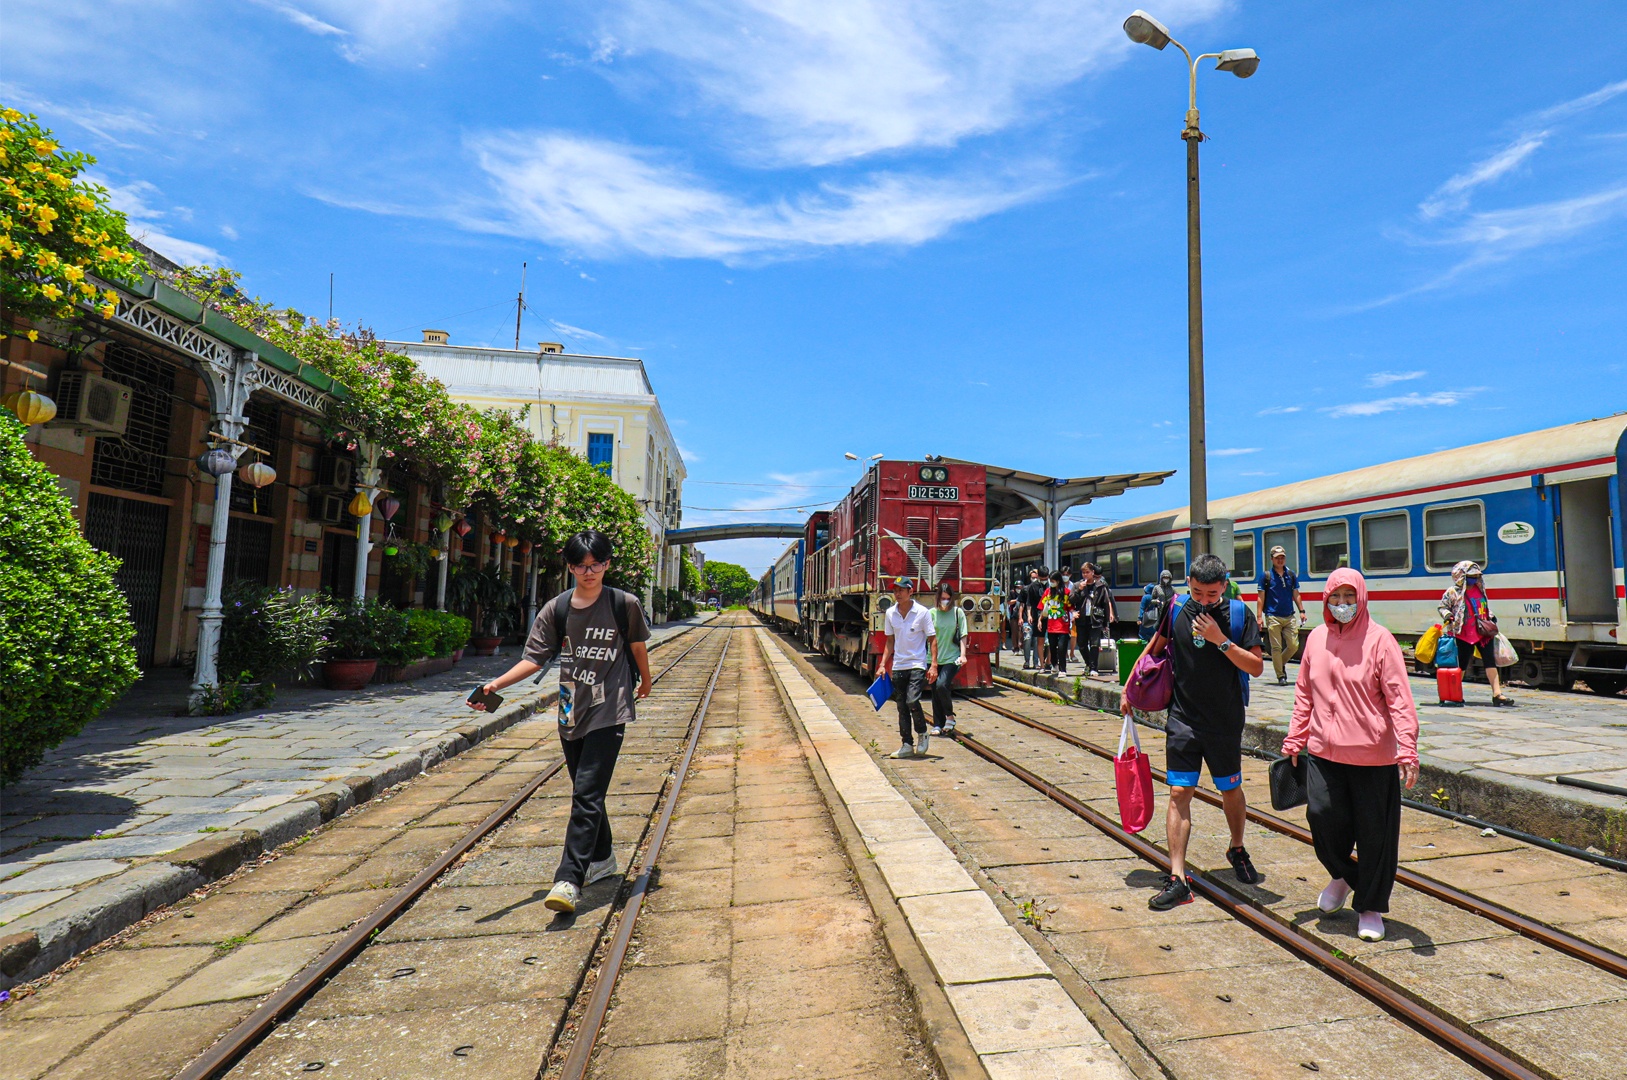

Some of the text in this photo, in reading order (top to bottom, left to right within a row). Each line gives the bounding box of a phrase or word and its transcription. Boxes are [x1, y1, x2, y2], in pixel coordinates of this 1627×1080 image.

[1523, 603, 1541, 613] VNR
[1518, 616, 1551, 627] A 31558
[585, 627, 615, 641] THE
[575, 645, 618, 662] GREEN
[572, 666, 597, 686] LAB
